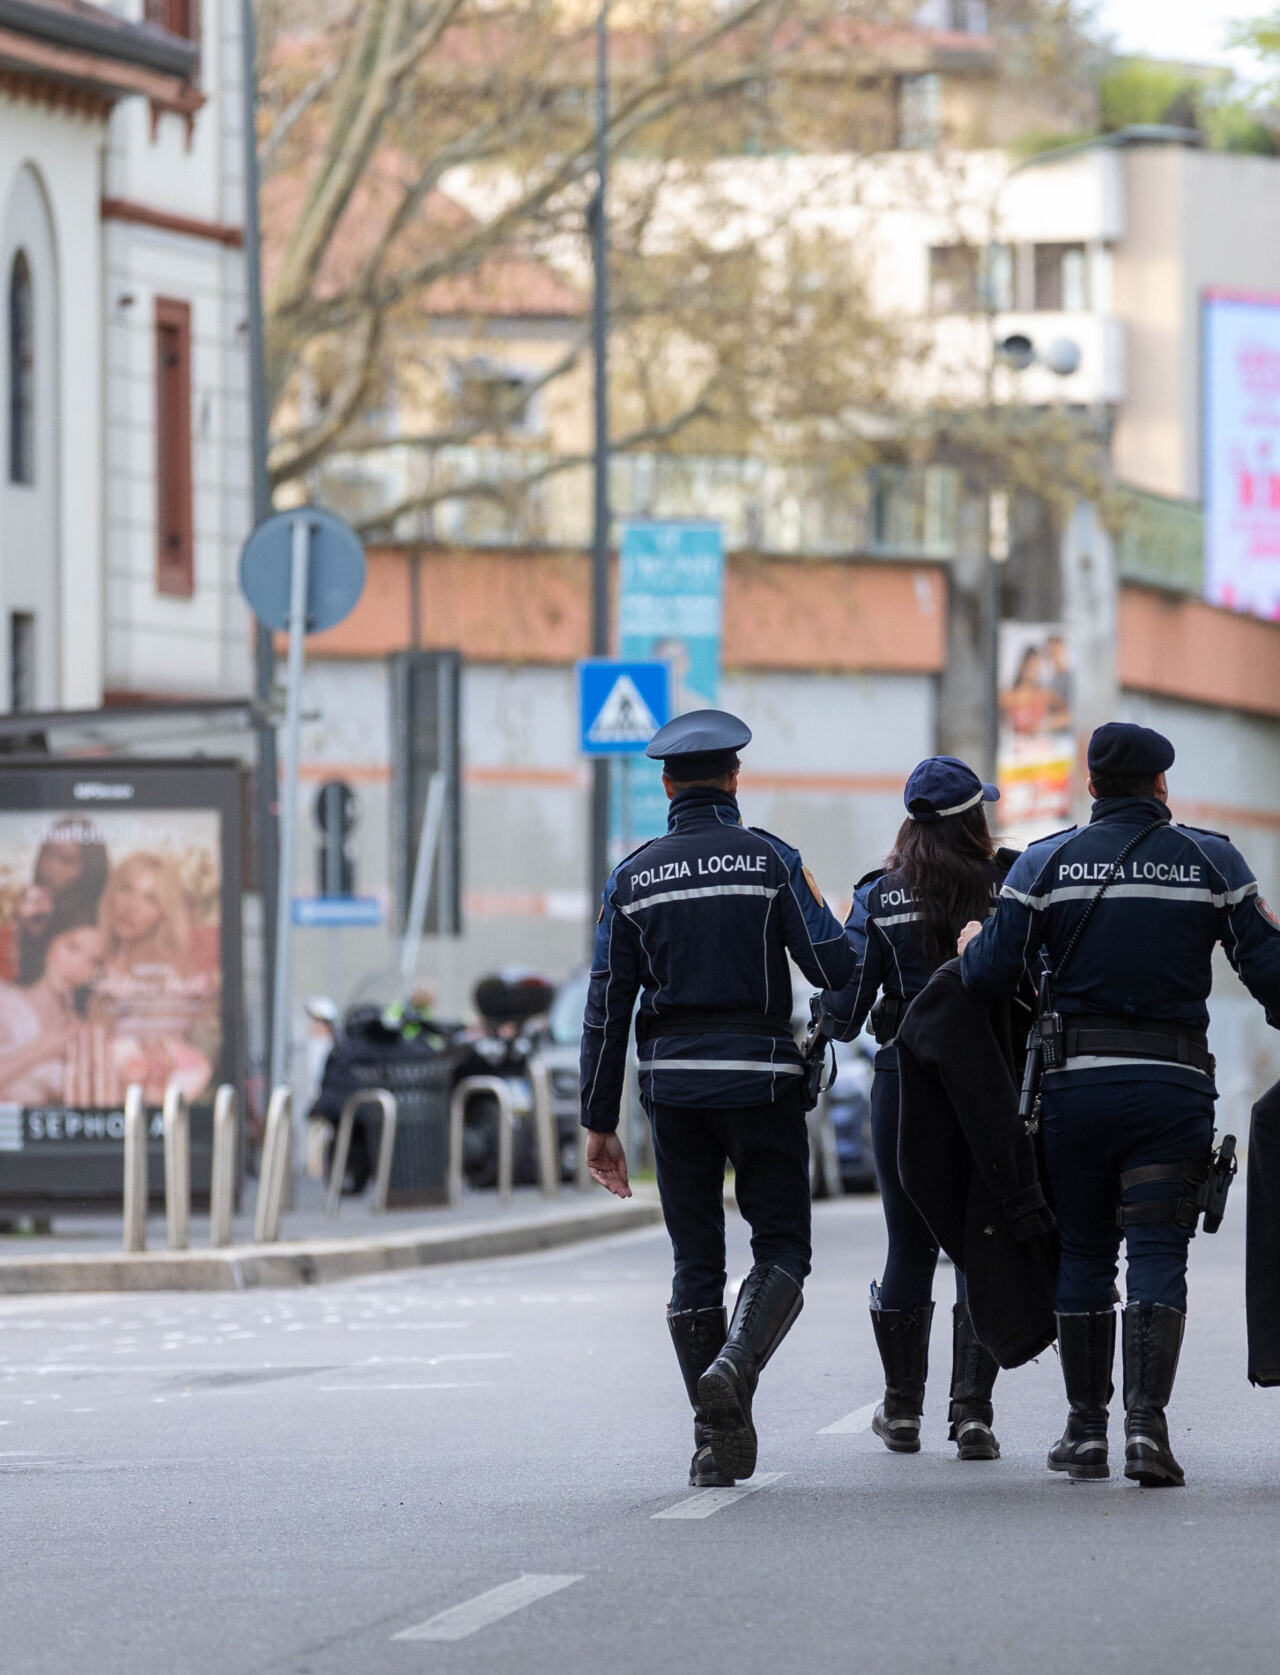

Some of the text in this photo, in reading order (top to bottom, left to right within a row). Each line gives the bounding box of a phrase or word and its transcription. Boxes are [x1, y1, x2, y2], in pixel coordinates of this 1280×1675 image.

[630, 855, 767, 891] POLIZIA LOCALE
[1133, 862, 1201, 882] LOCALE
